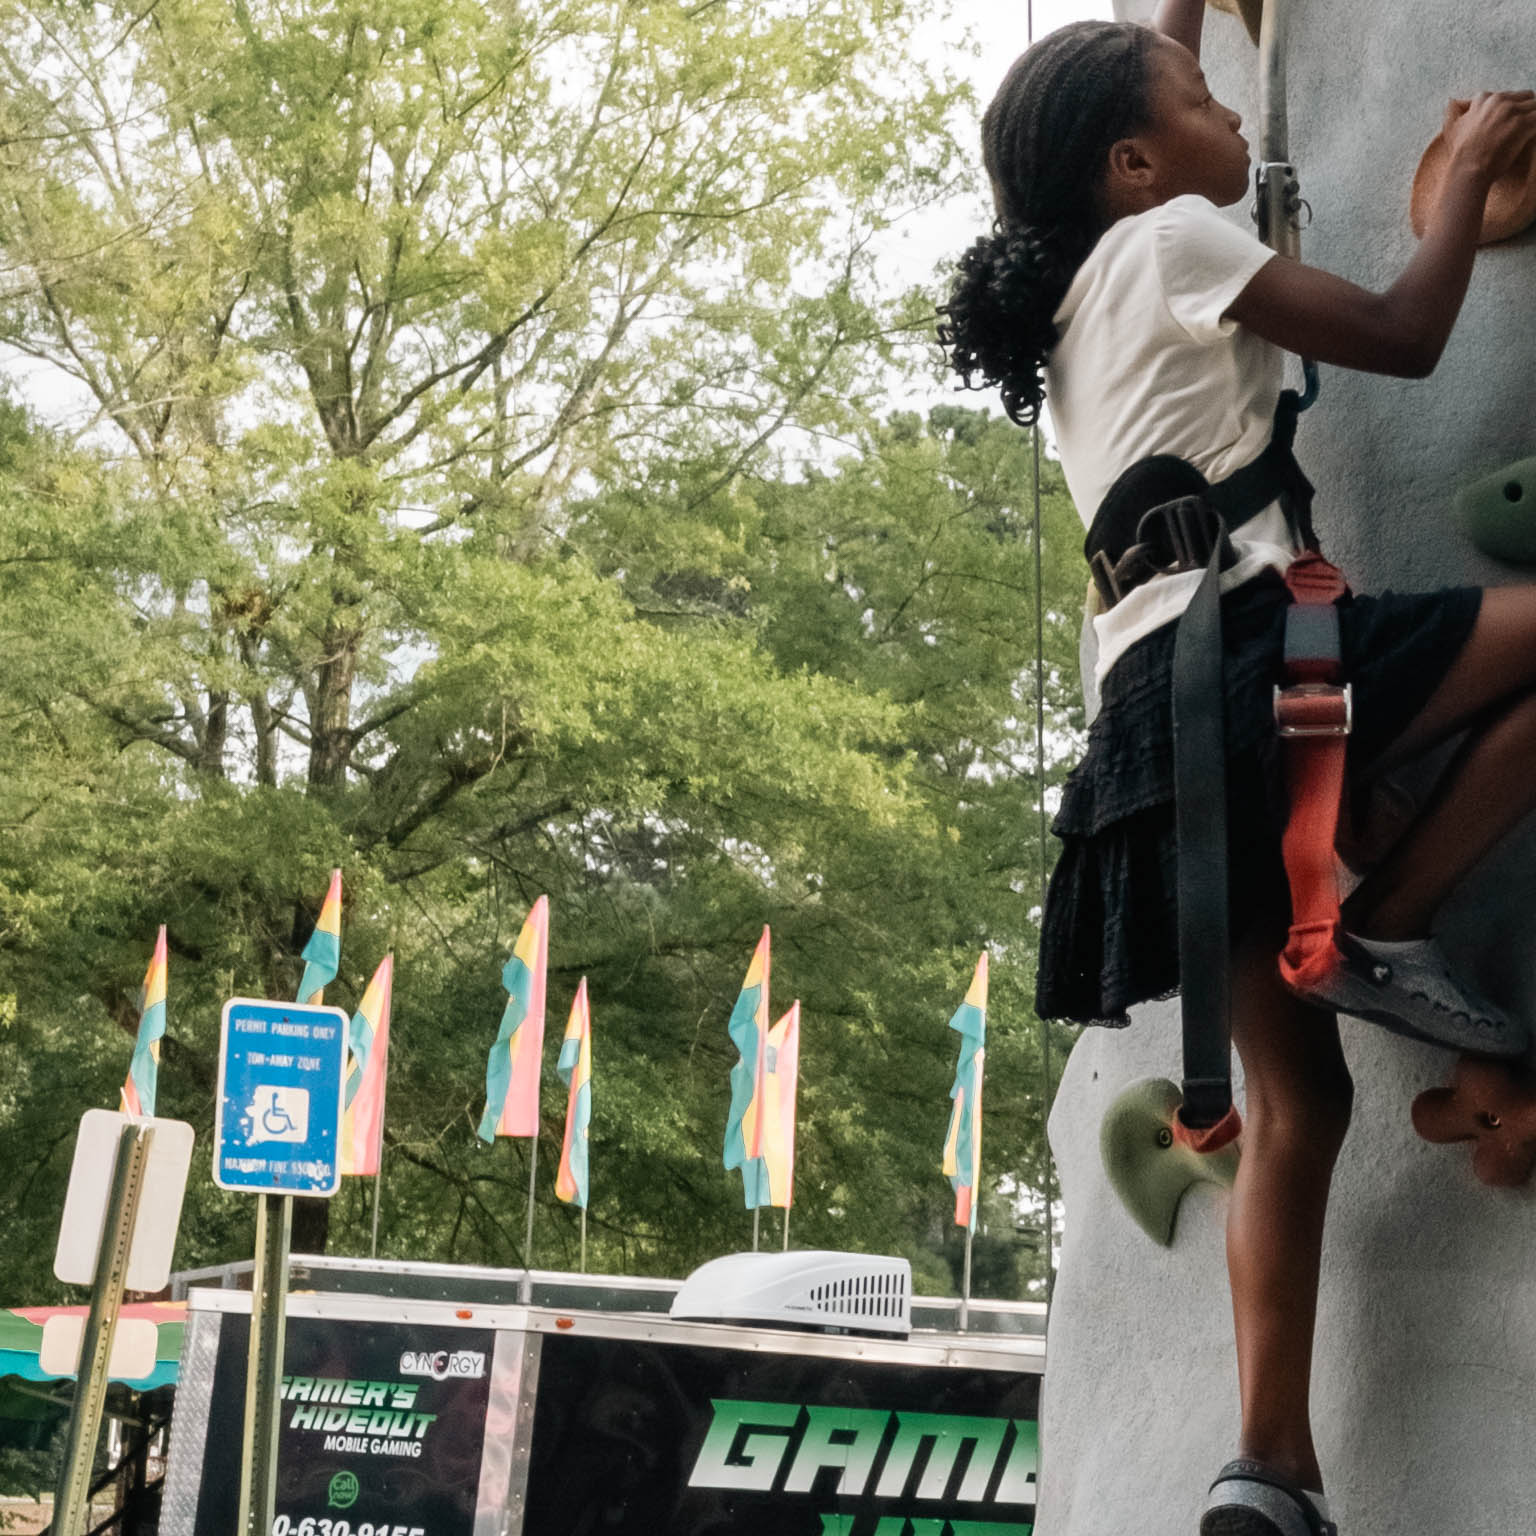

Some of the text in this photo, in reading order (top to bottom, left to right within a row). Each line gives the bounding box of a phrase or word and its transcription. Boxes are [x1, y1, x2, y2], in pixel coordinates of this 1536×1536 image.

[400, 1350, 482, 1382] CYNERGY
[281, 1376, 419, 1408] AMER'S
[290, 1405, 437, 1438] HIDEOUT
[324, 1435, 422, 1458] MOBILE GAMING
